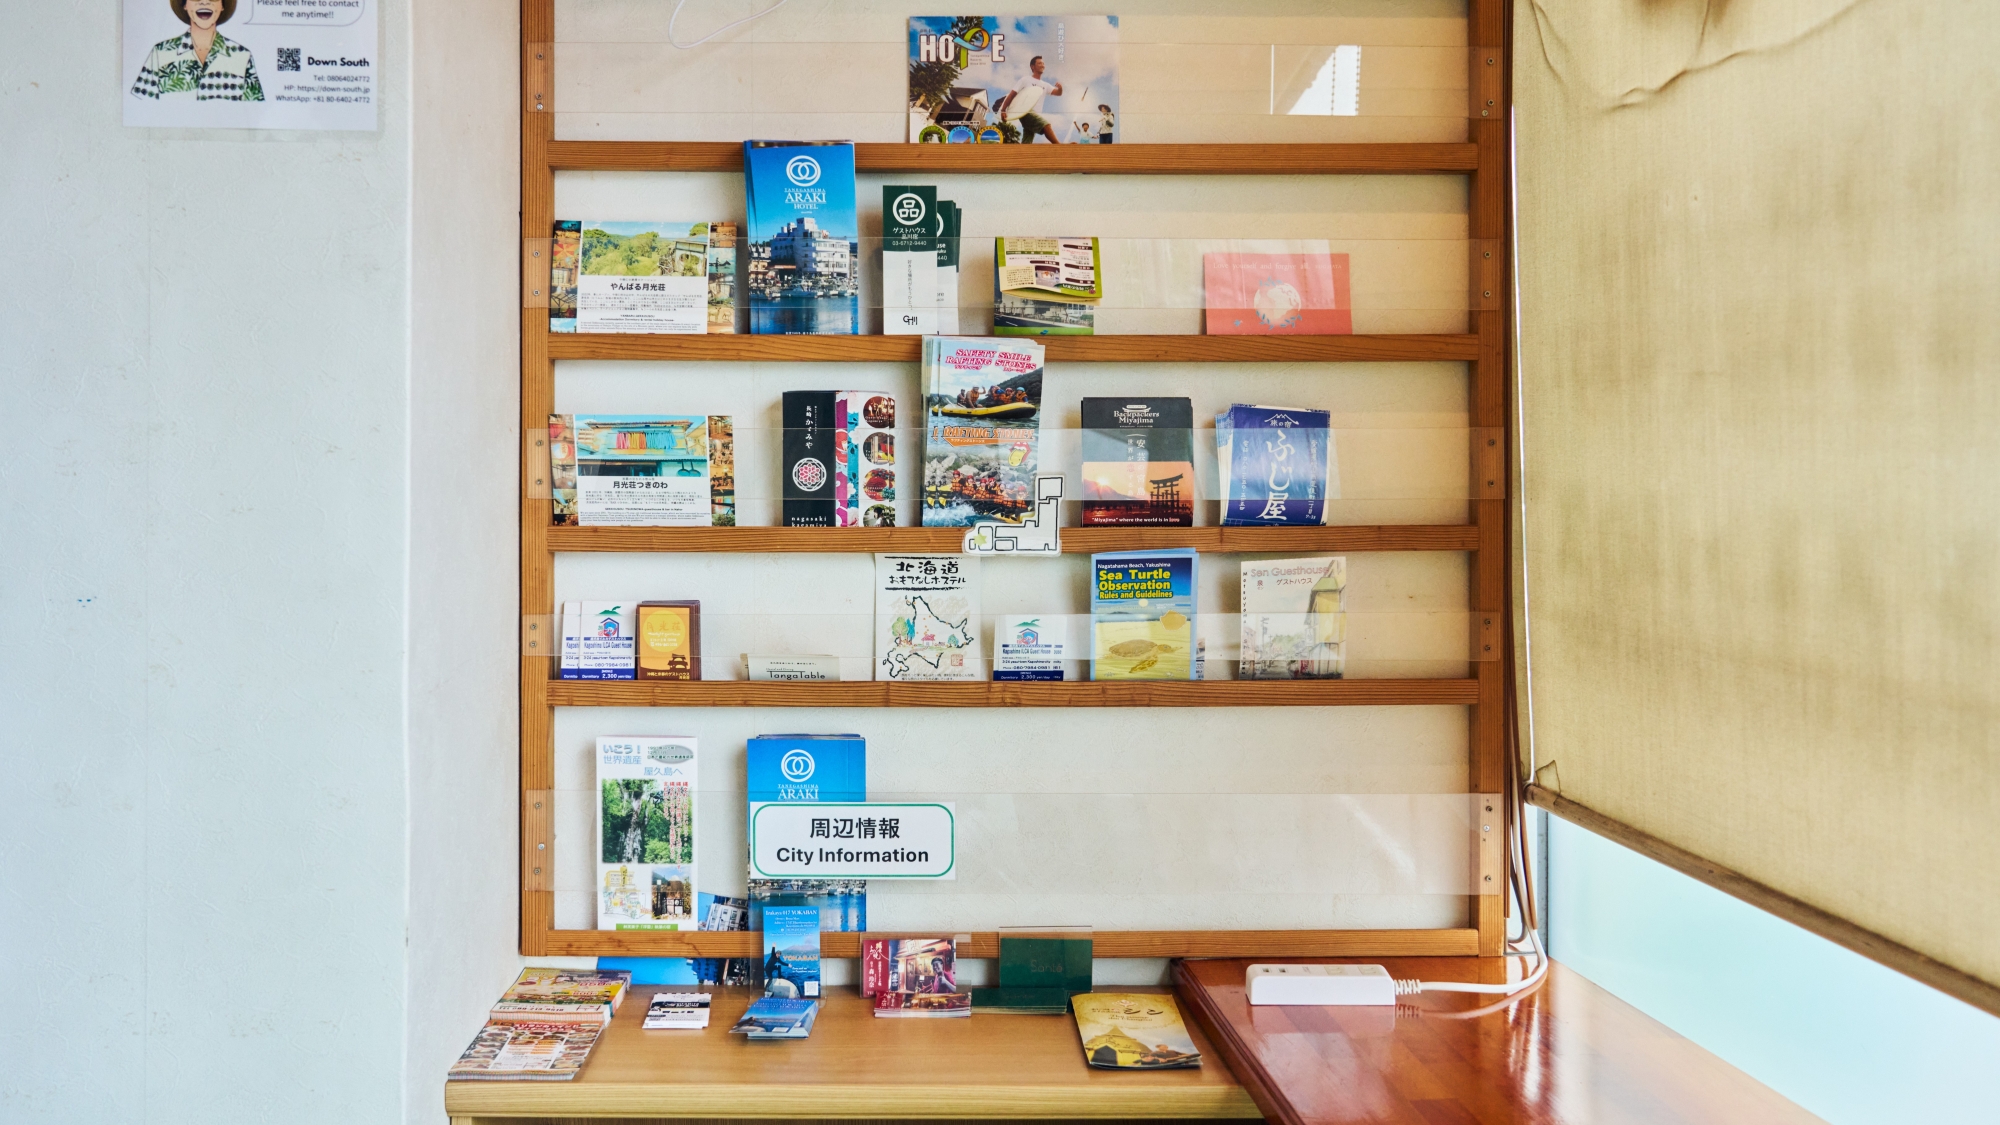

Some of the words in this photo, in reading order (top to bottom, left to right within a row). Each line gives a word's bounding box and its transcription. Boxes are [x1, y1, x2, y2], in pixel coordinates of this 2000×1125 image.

[296, 10, 334, 20] anytime!!
[919, 27, 1006, 70] HOPE
[307, 56, 337, 66] Down
[340, 57, 370, 67] South
[297, 85, 370, 94] https://down-south.jp
[276, 95, 312, 103] WhatsApp:
[785, 192, 827, 202] ARAKI
[1232, 262, 1258, 270] yourself
[1260, 262, 1272, 270] and
[1275, 262, 1297, 272] forgive
[610, 283, 666, 292] やんばる月光荘
[956, 348, 997, 358] SAFETY
[998, 352, 1032, 362] SMILE
[946, 356, 992, 366] RAFTING
[994, 360, 1037, 370] STONES
[1113, 410, 1160, 418] Backpackers
[1118, 416, 1154, 425] Miyajima
[943, 426, 990, 438] RAFTING
[990, 428, 1035, 439] STONES
[1256, 429, 1295, 520] ふじ屋
[612, 481, 668, 489] 月光荘つきのわ
[896, 560, 959, 575] 北海道
[1250, 568, 1269, 578] Sen
[1271, 566, 1330, 576] Guesthouse
[1099, 570, 1123, 581] Sea
[1128, 568, 1171, 580] Turtle
[888, 575, 966, 585] おもてなしホステル
[1099, 580, 1171, 591] Observation
[1100, 591, 1119, 599] Rules
[1135, 590, 1172, 598] Guidelines
[603, 744, 641, 754] いこう！
[604, 755, 642, 765] 世界遺産
[644, 766, 683, 776] 屋久島へ
[778, 789, 818, 800] ARAKI
[810, 817, 900, 839] 周辺情報
[776, 847, 814, 866] City
[820, 846, 930, 862] Information
